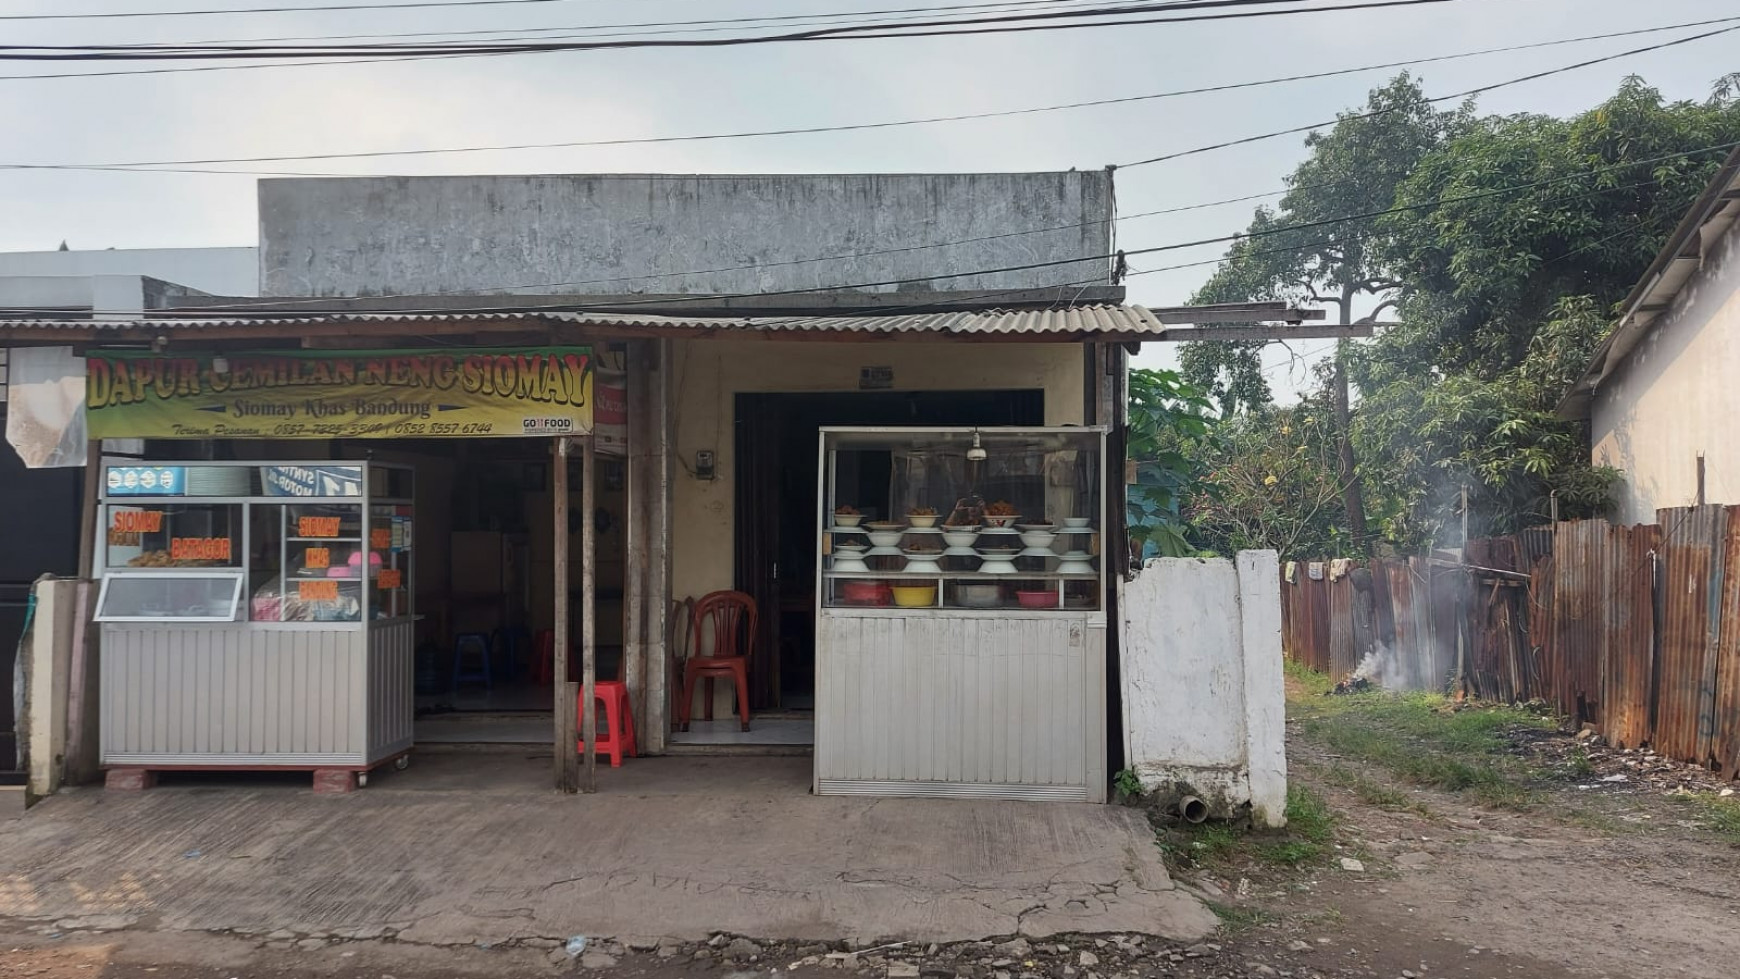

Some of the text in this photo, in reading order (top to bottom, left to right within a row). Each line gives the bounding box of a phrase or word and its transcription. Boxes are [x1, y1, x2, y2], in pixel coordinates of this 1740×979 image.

[86, 357, 200, 409] DAPUR
[209, 357, 356, 392] CEMILAN
[365, 355, 459, 391] NENG
[462, 353, 590, 408] SIOMAY
[233, 398, 431, 420] Siomay Khas Bandung
[172, 424, 210, 435] Terima
[214, 424, 260, 435] Pesanan
[394, 422, 425, 434] 0852
[430, 422, 459, 434] 8557
[462, 422, 493, 434] 6744
[114, 511, 162, 533] SIOMAY
[172, 538, 231, 560] BATAGOR
